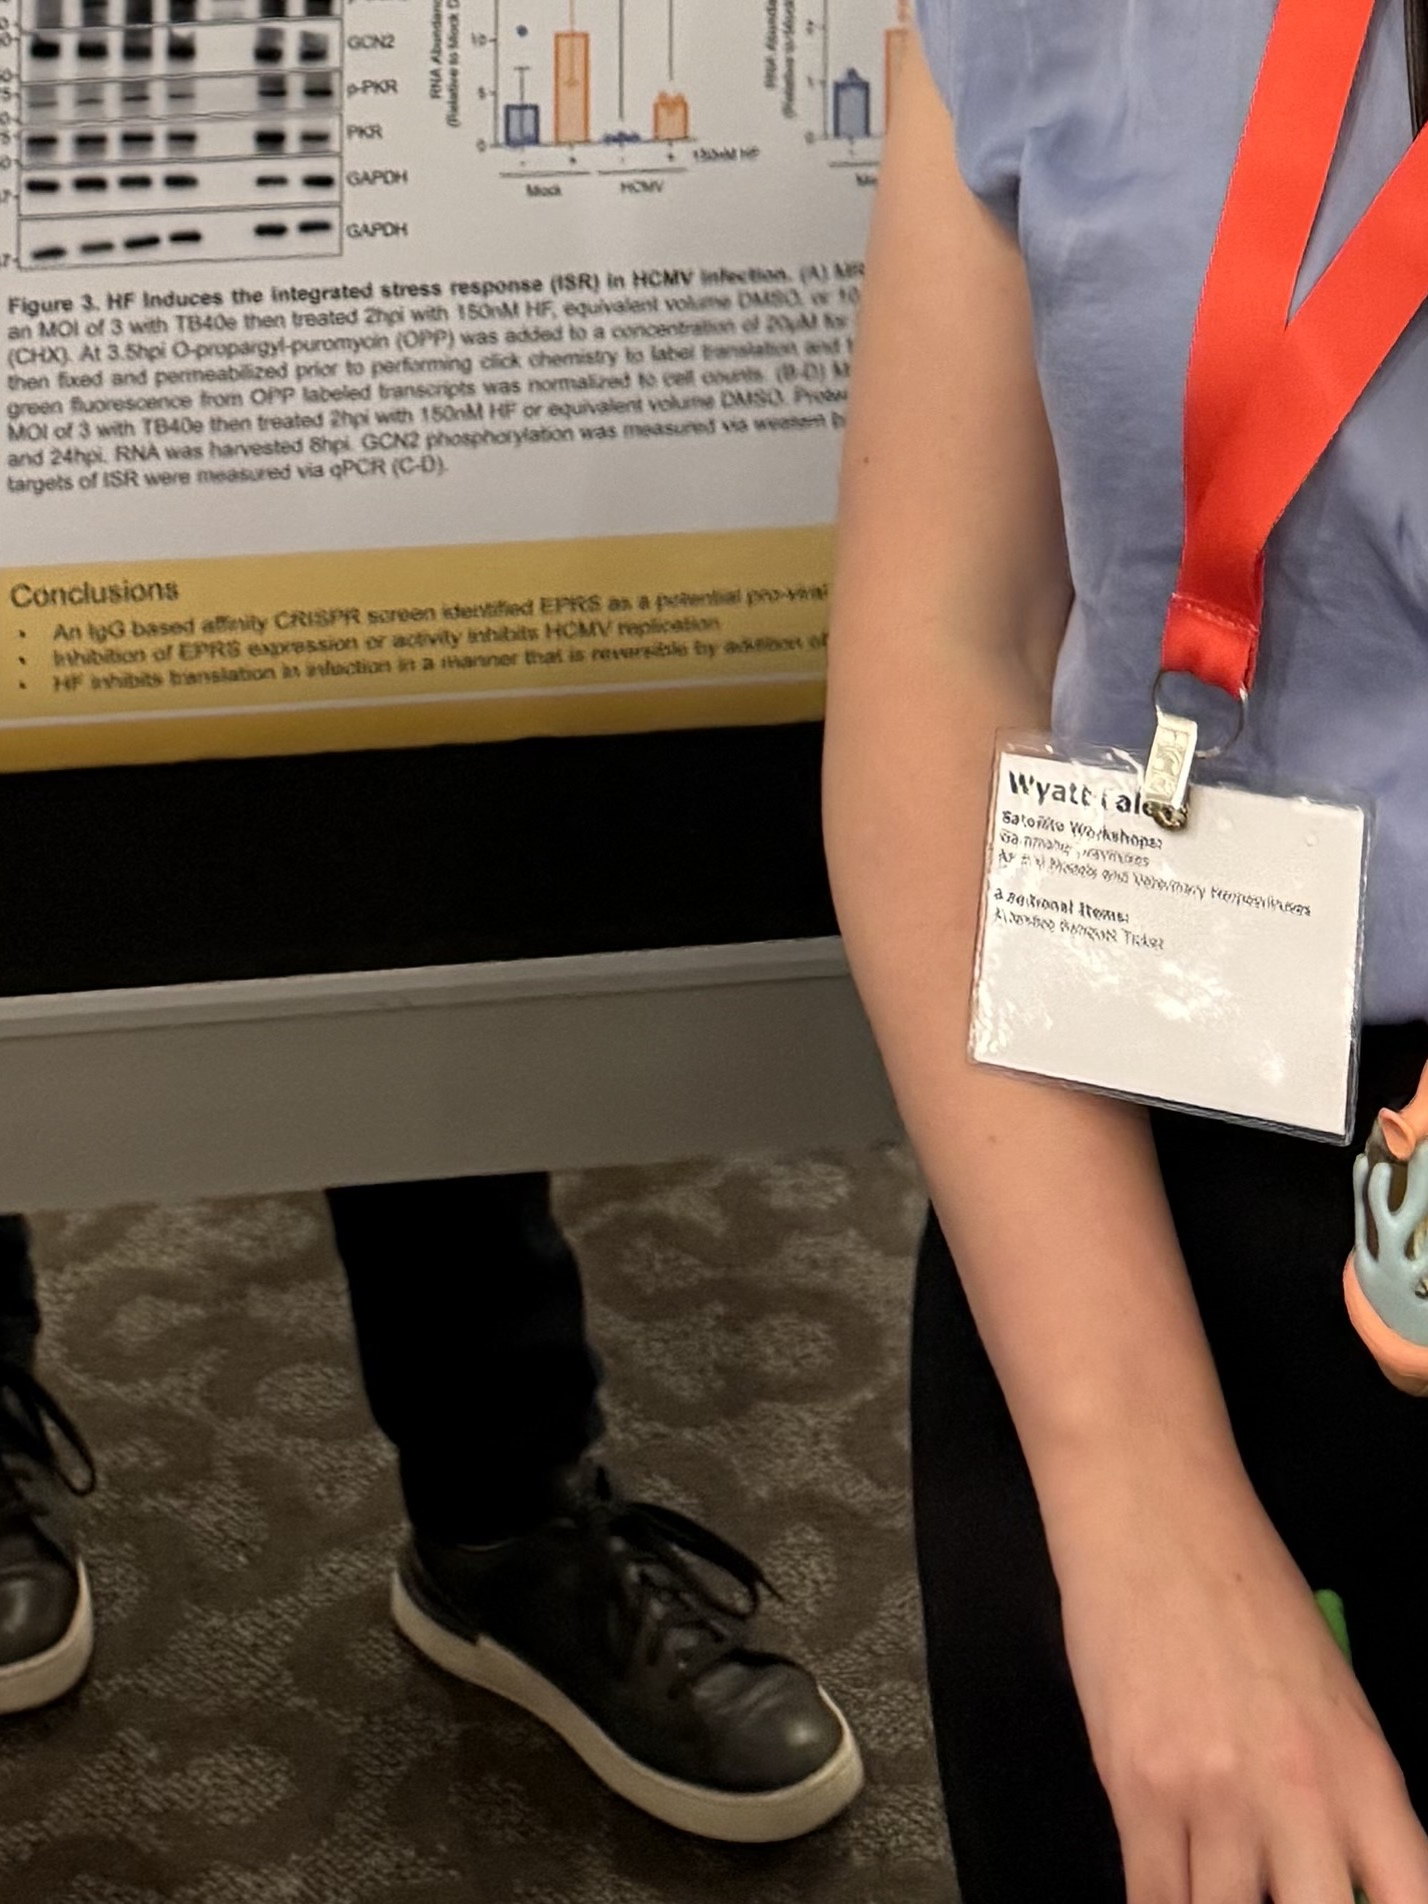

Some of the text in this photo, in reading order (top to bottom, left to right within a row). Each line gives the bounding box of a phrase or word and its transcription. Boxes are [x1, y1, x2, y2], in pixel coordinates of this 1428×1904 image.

[345, 168, 409, 187] GAPDH
[7, 267, 792, 319] Figure 3. HF Induces the integrated stress response (ISR) in HCMV infection.
[9, 579, 180, 609] Conclusions
[1009, 771, 1093, 806] Wyatt
